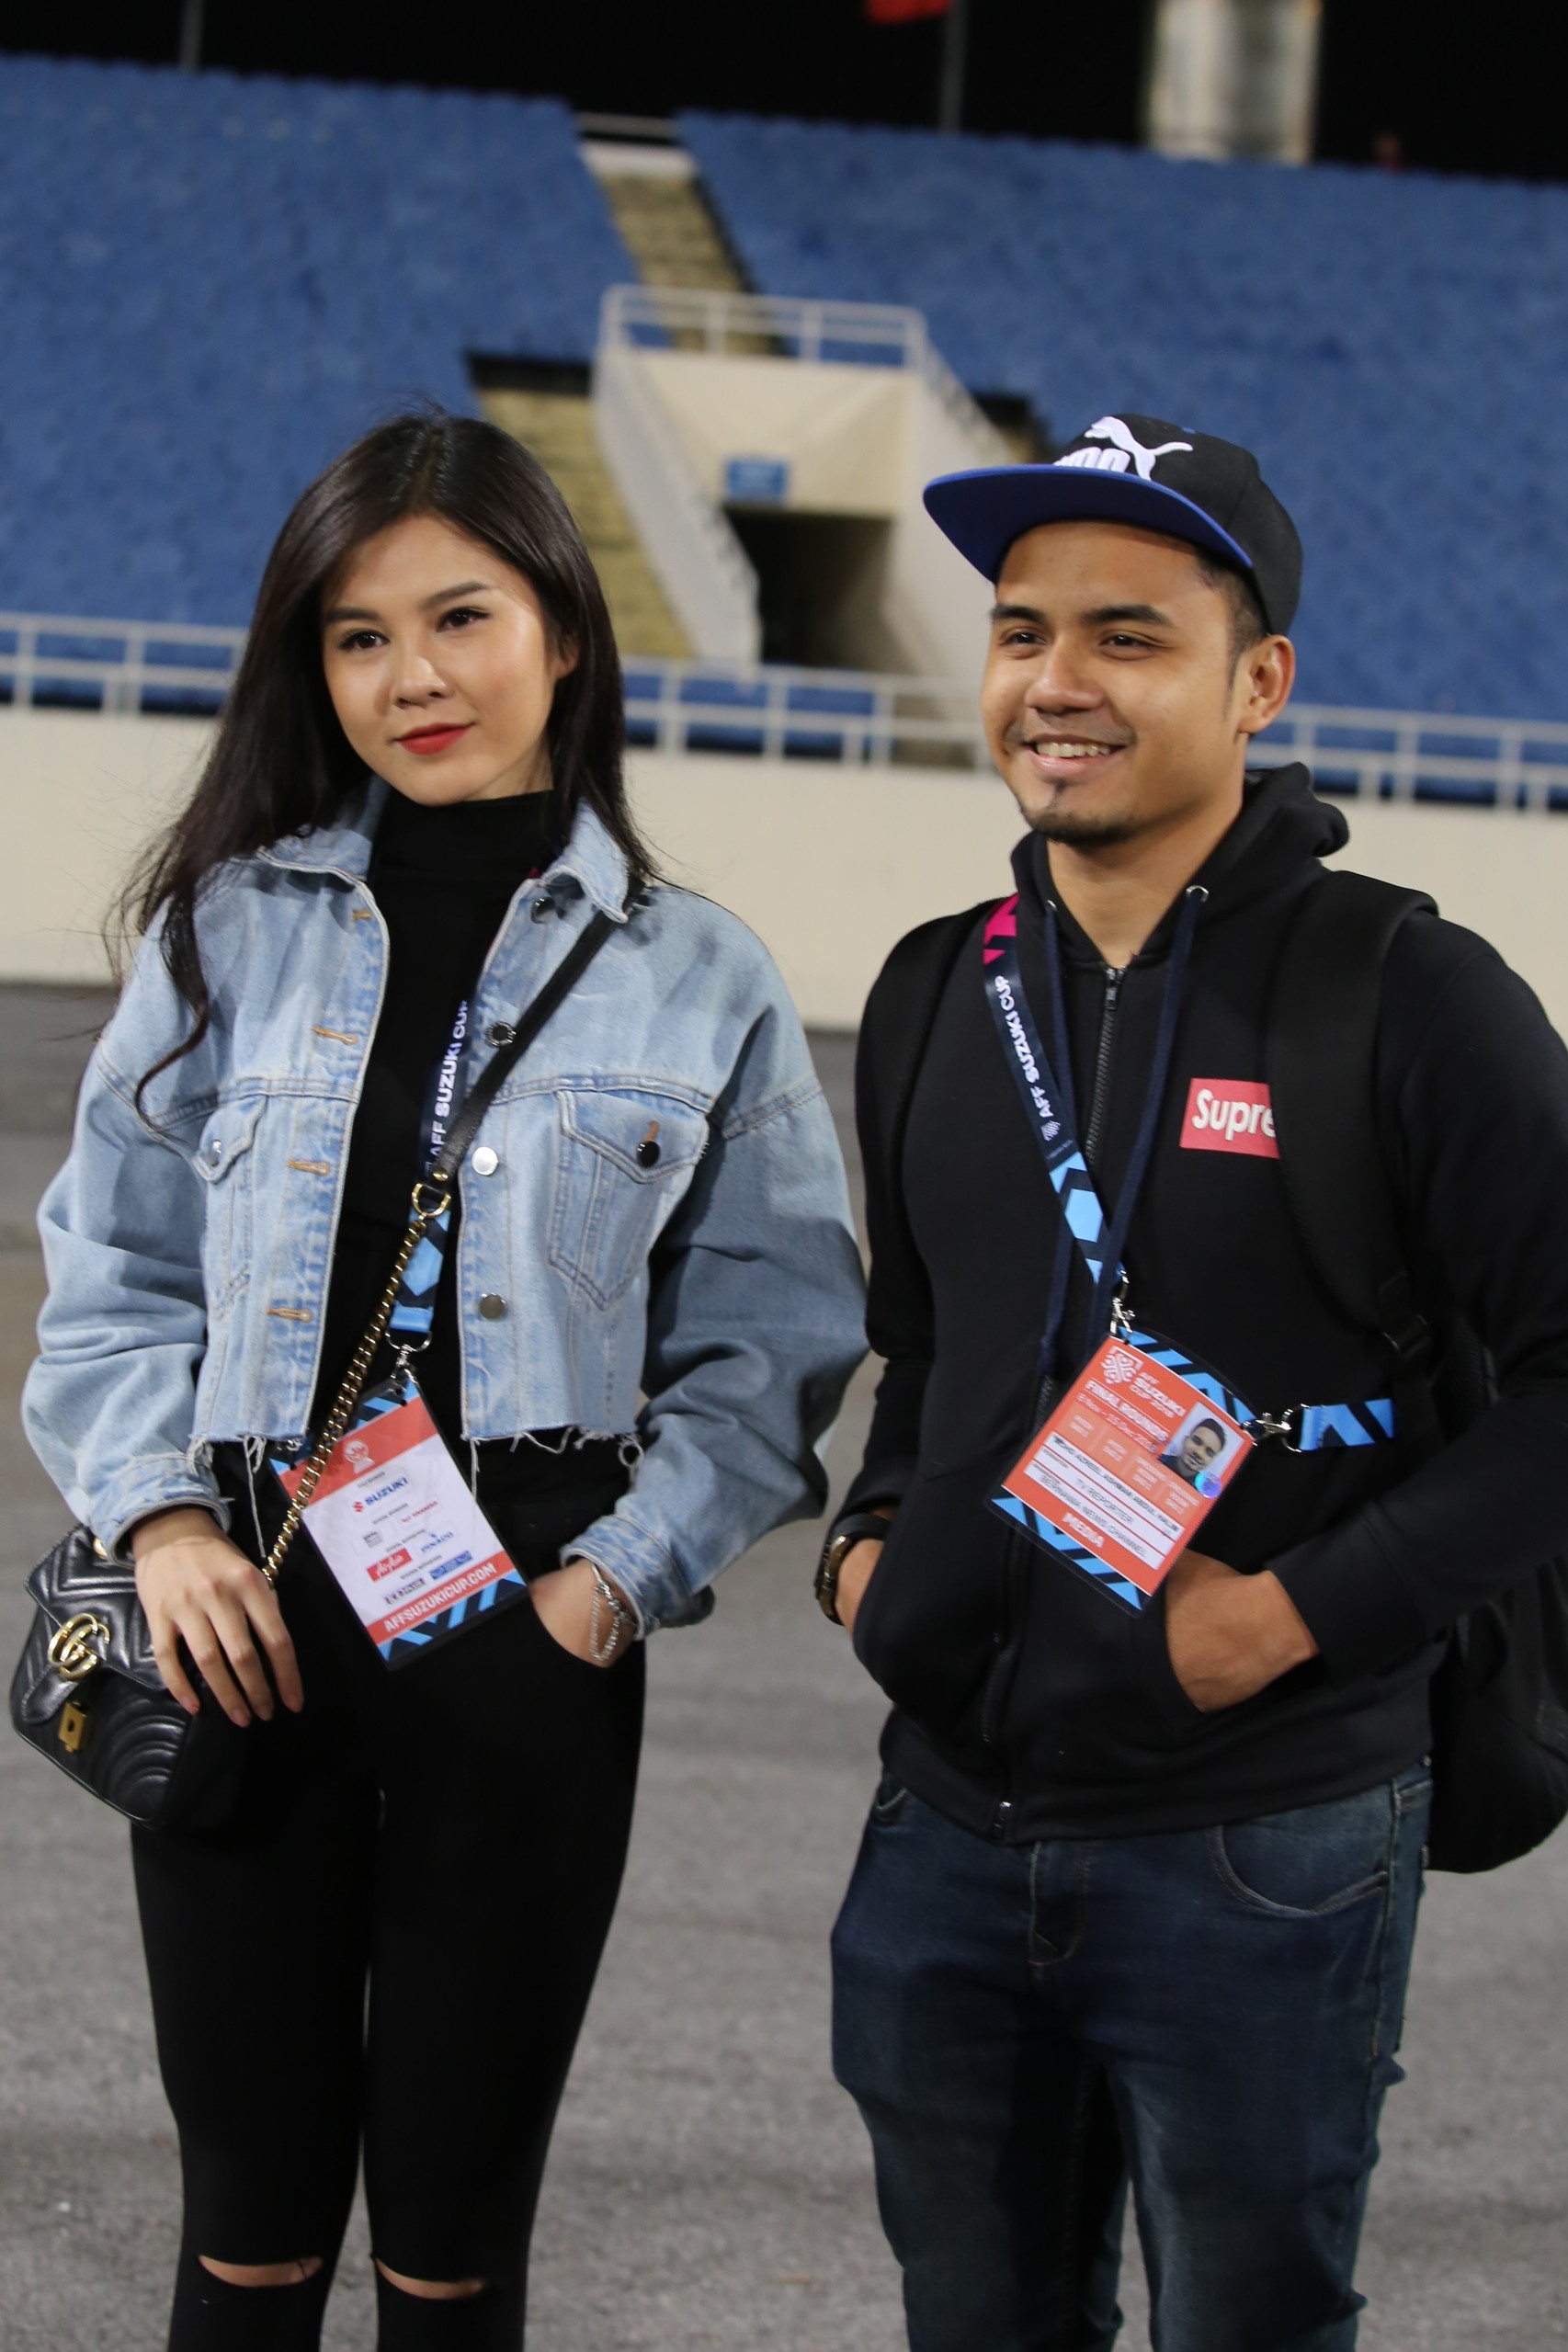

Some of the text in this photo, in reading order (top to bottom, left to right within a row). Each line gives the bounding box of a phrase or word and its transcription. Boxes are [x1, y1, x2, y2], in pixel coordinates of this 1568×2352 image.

[994, 975, 1053, 1117] AFF SUZUKI CUP
[435, 1042, 460, 1117] SUZUKI
[1084, 1379, 1120, 1408] FINAL
[1117, 1402, 1169, 1442] ROUNDS
[1128, 1383, 1151, 1400] CUP
[1132, 1376, 1186, 1416] SUZUKI
[1083, 1397, 1102, 1414] Nov
[1117, 1420, 1135, 1437] Dec
[364, 1475, 408, 1506] SUZUKI
[1086, 1487, 1134, 1524] REPORTER
[1062, 1512, 1104, 1549] MEDIA
[382, 1562, 497, 1632] AFFSUZUKICUP.COM
